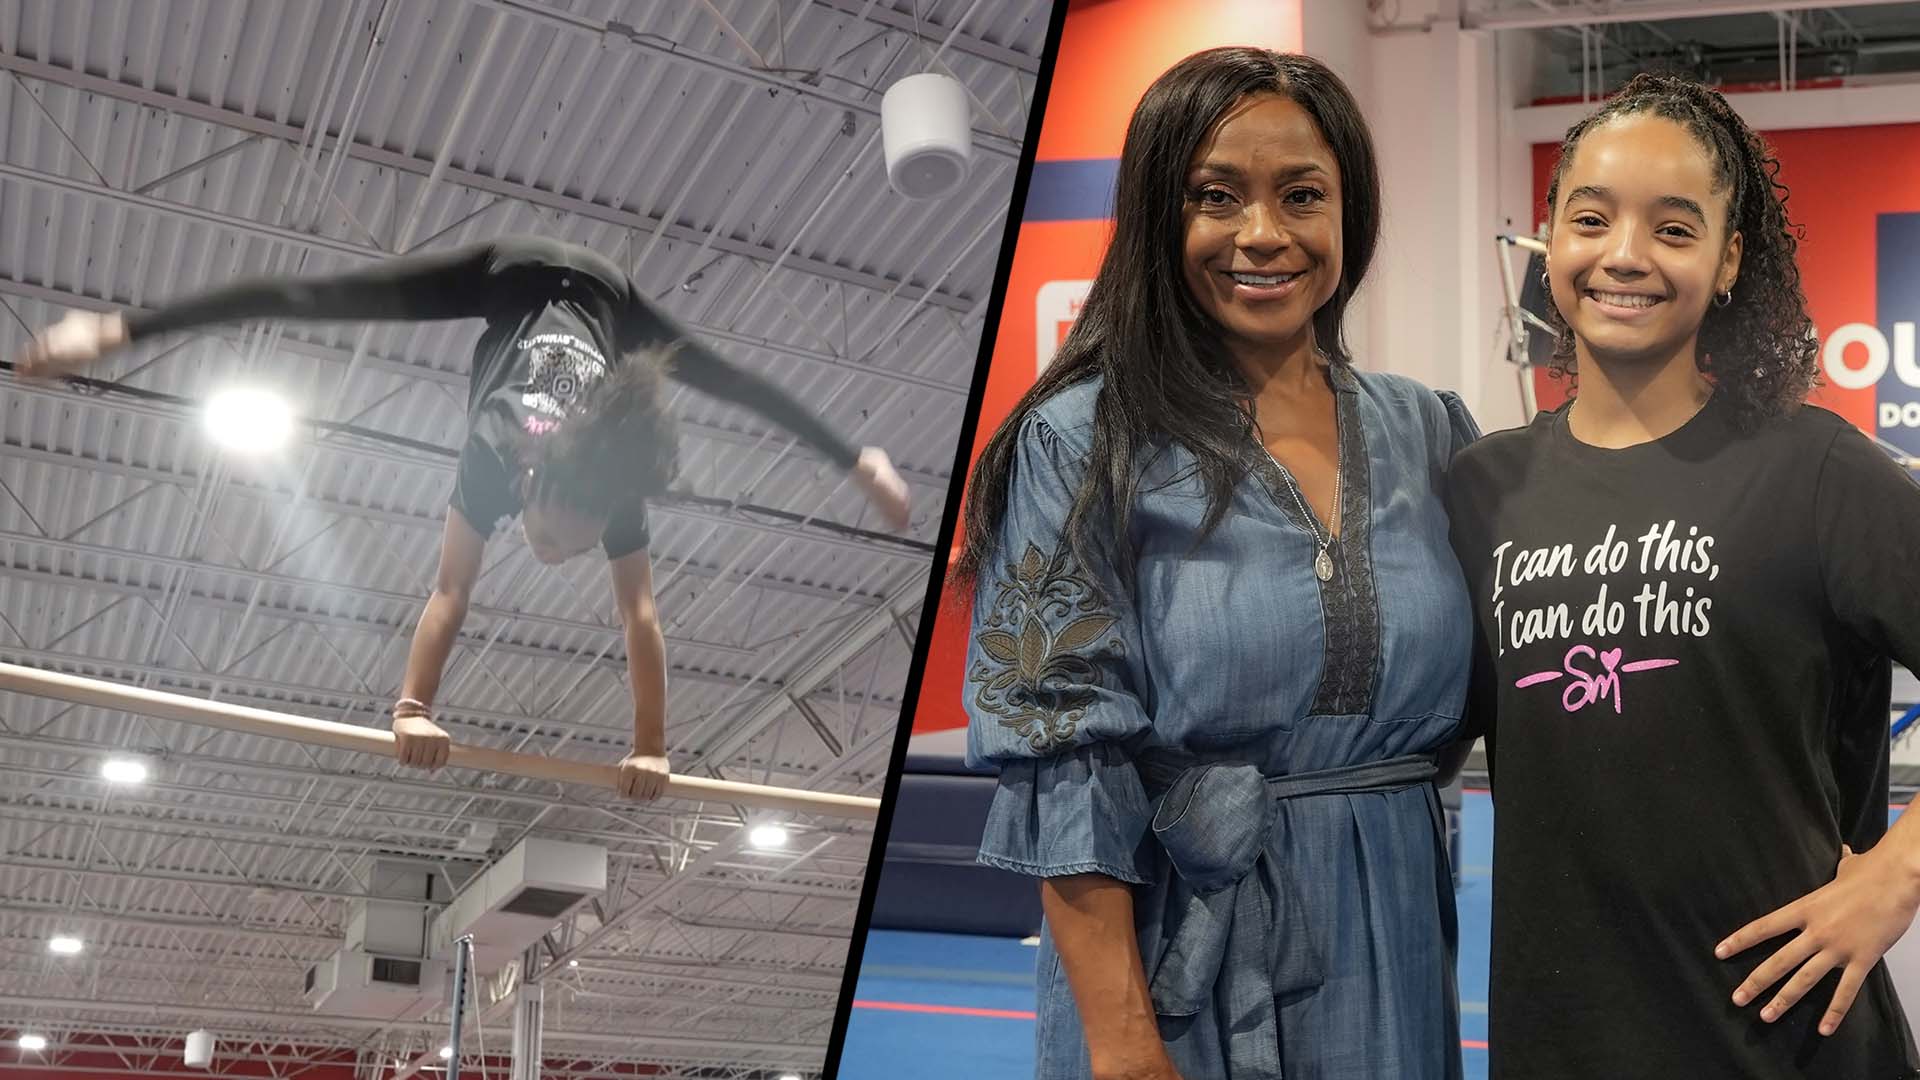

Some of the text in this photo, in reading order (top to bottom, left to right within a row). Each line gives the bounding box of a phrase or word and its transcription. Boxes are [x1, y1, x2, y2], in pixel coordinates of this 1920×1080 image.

[1493, 519, 1720, 602] I can do this,
[1494, 580, 1713, 658] I can do this
